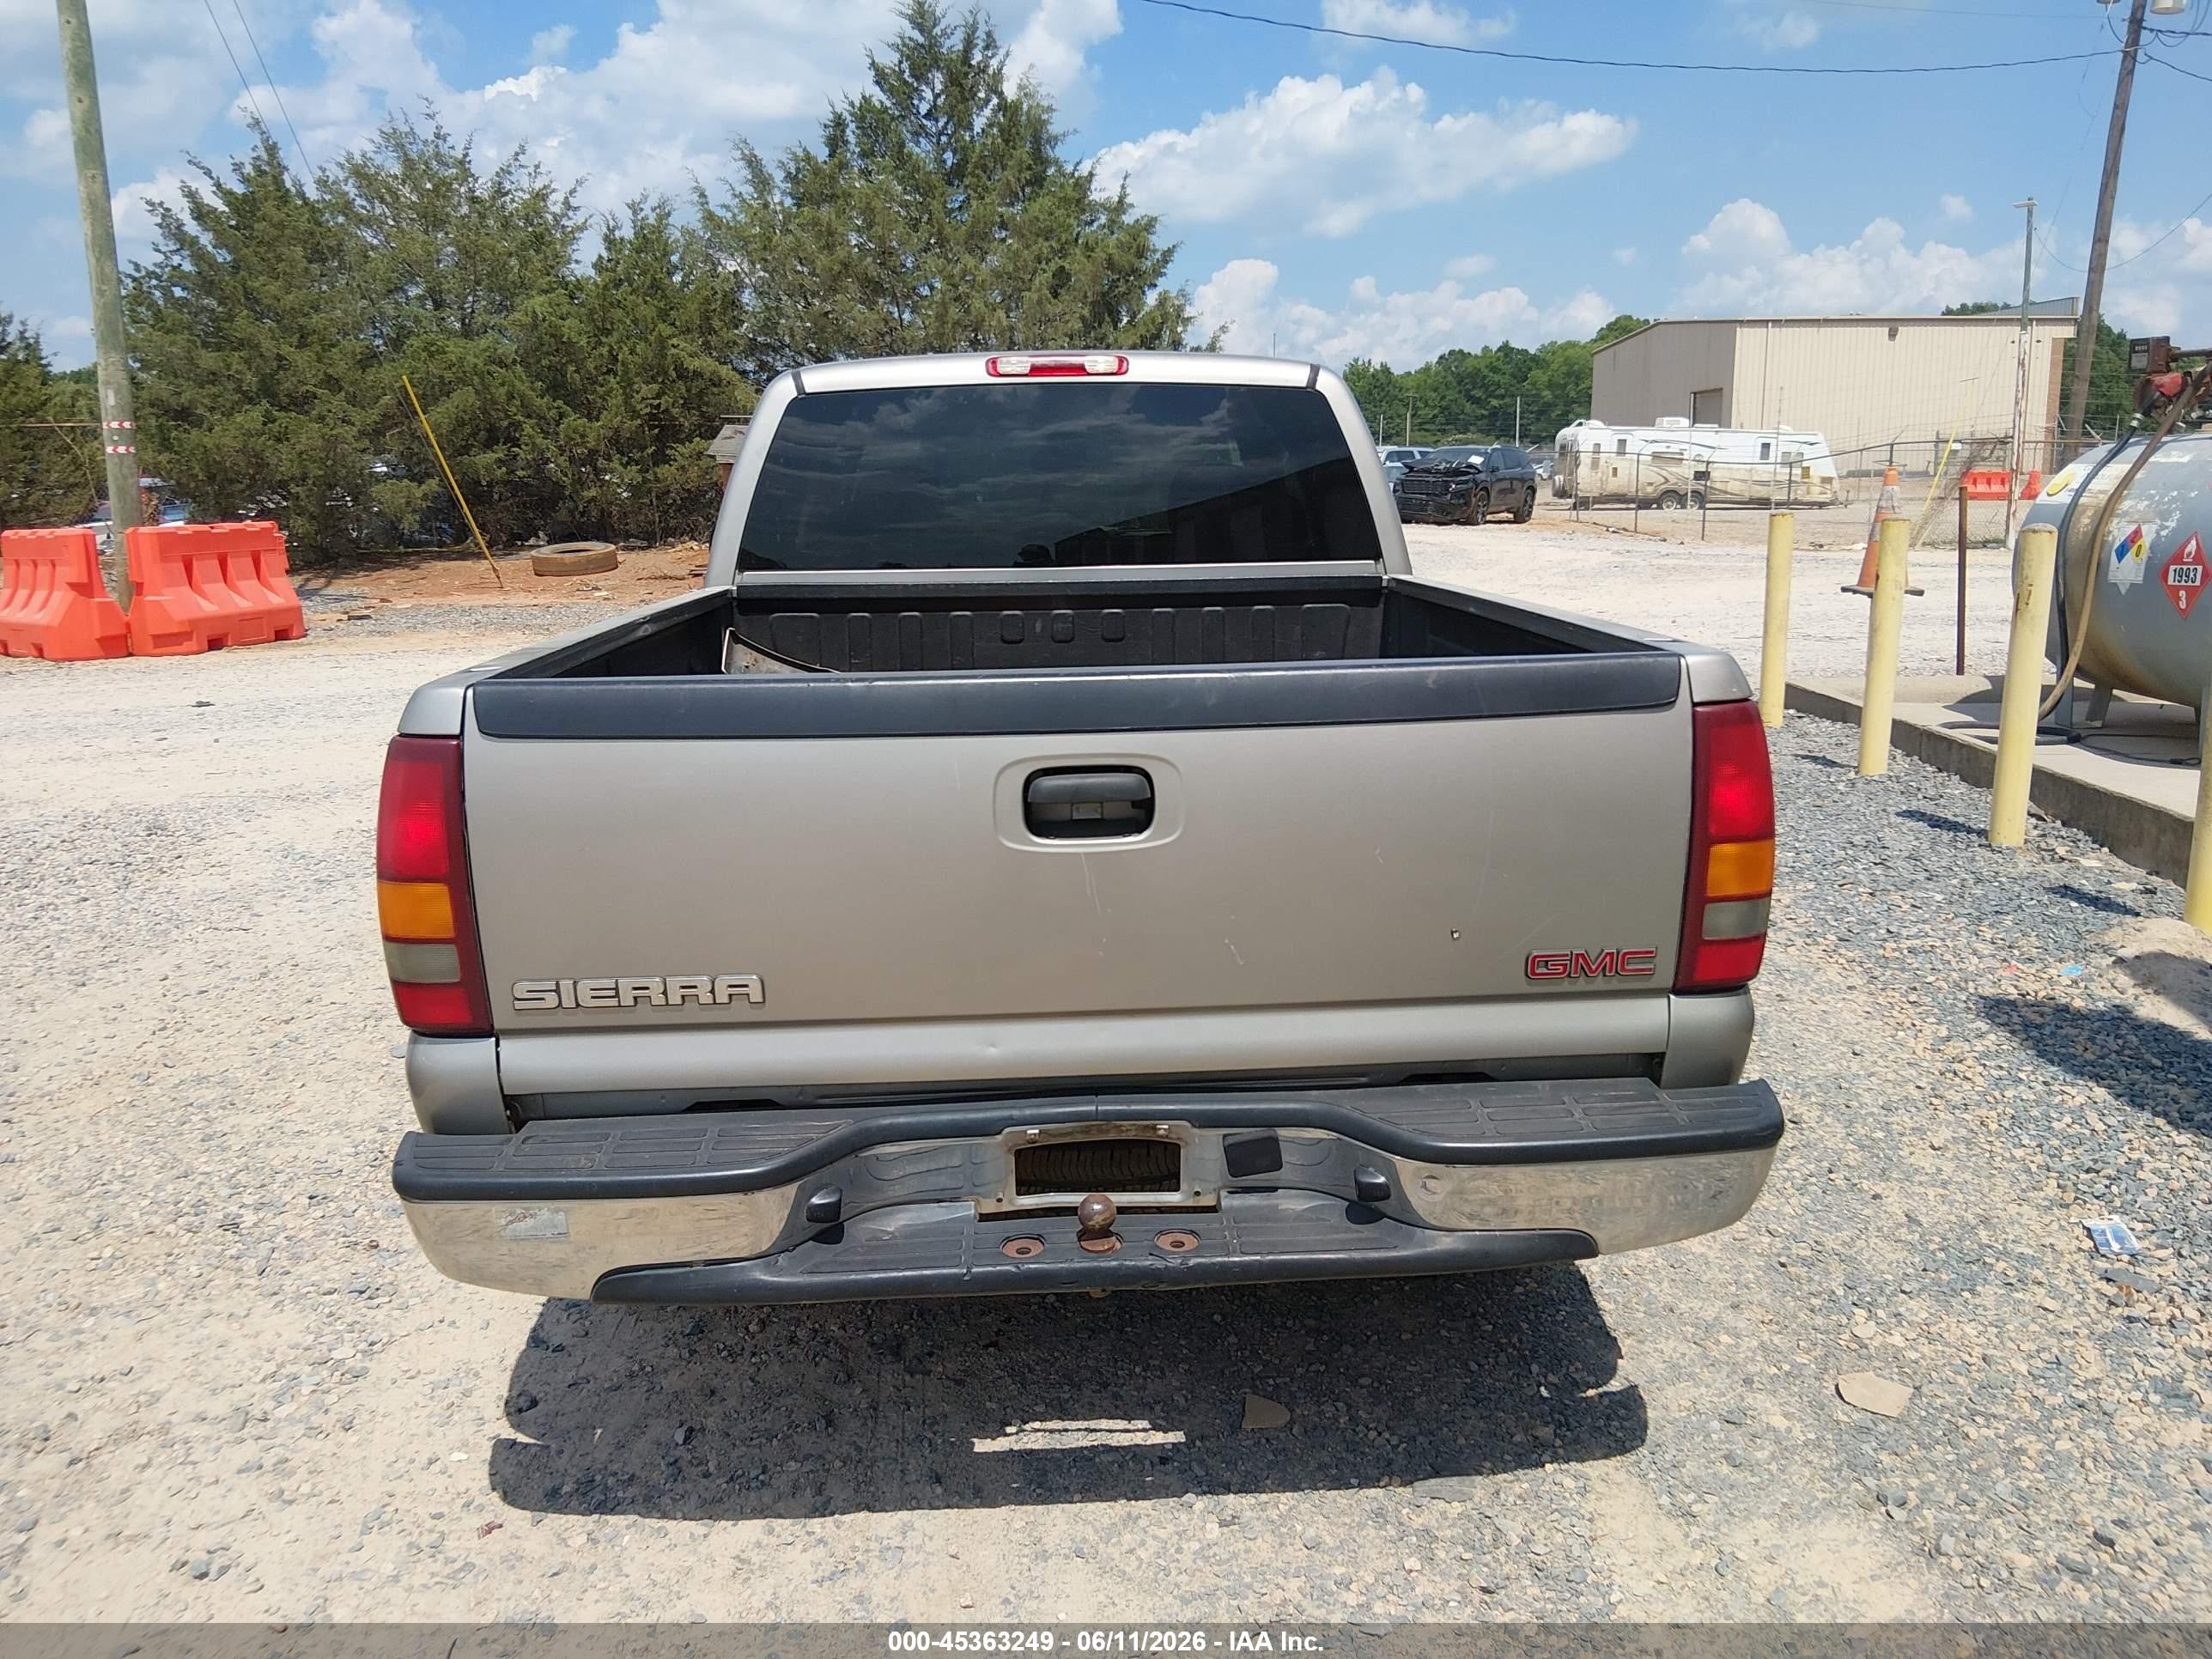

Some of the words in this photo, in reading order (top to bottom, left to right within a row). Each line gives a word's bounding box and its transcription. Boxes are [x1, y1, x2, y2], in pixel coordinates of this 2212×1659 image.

[2172, 567, 2198, 584] 1993
[2179, 590, 2186, 610] 3
[1526, 947, 1657, 979] GMC
[513, 974, 764, 1011] SIERRA
